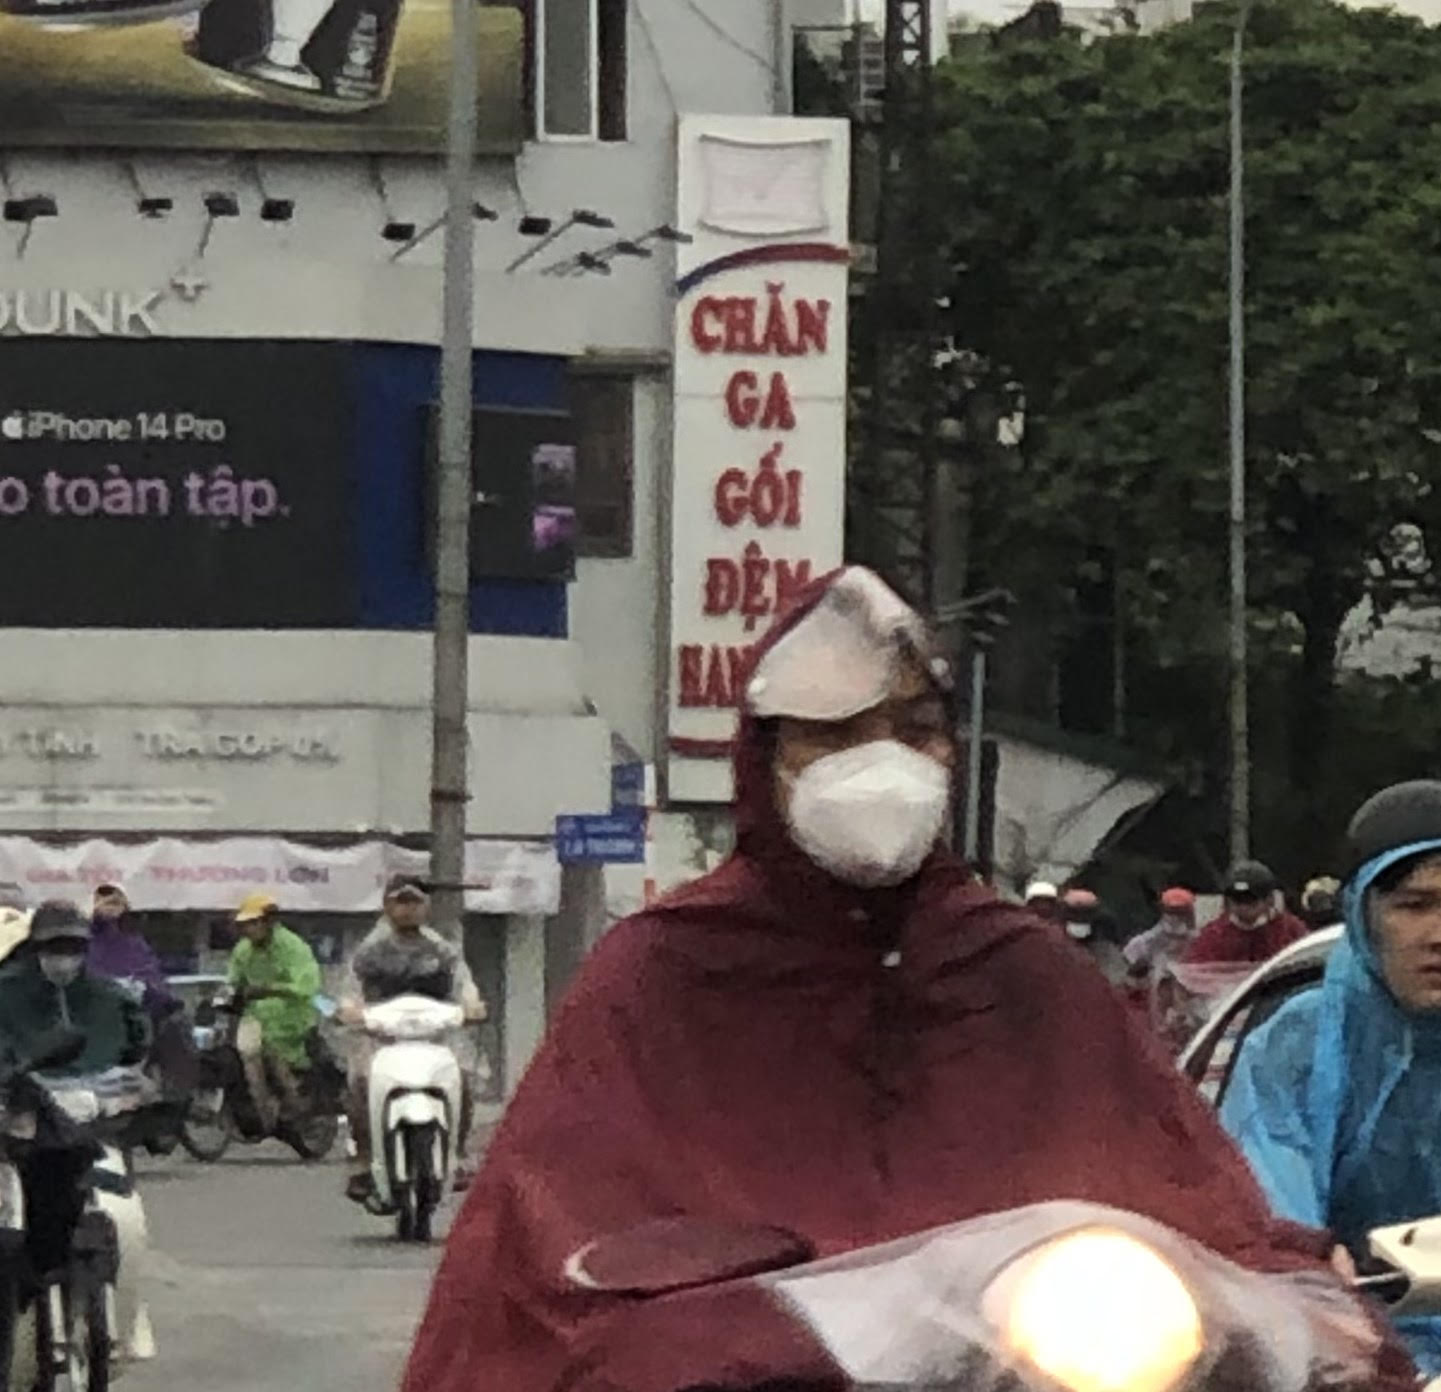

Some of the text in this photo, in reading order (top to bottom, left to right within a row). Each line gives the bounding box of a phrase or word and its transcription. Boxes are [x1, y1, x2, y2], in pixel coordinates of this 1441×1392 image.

[0, 288, 160, 334] UNK
[691, 281, 830, 356] CHĂN
[28, 411, 226, 441] iPhone 14 Pro
[725, 371, 796, 430] GA
[44, 464, 169, 515] toàn
[715, 441, 802, 528] GỐI
[703, 539, 813, 632] ĐỆM
